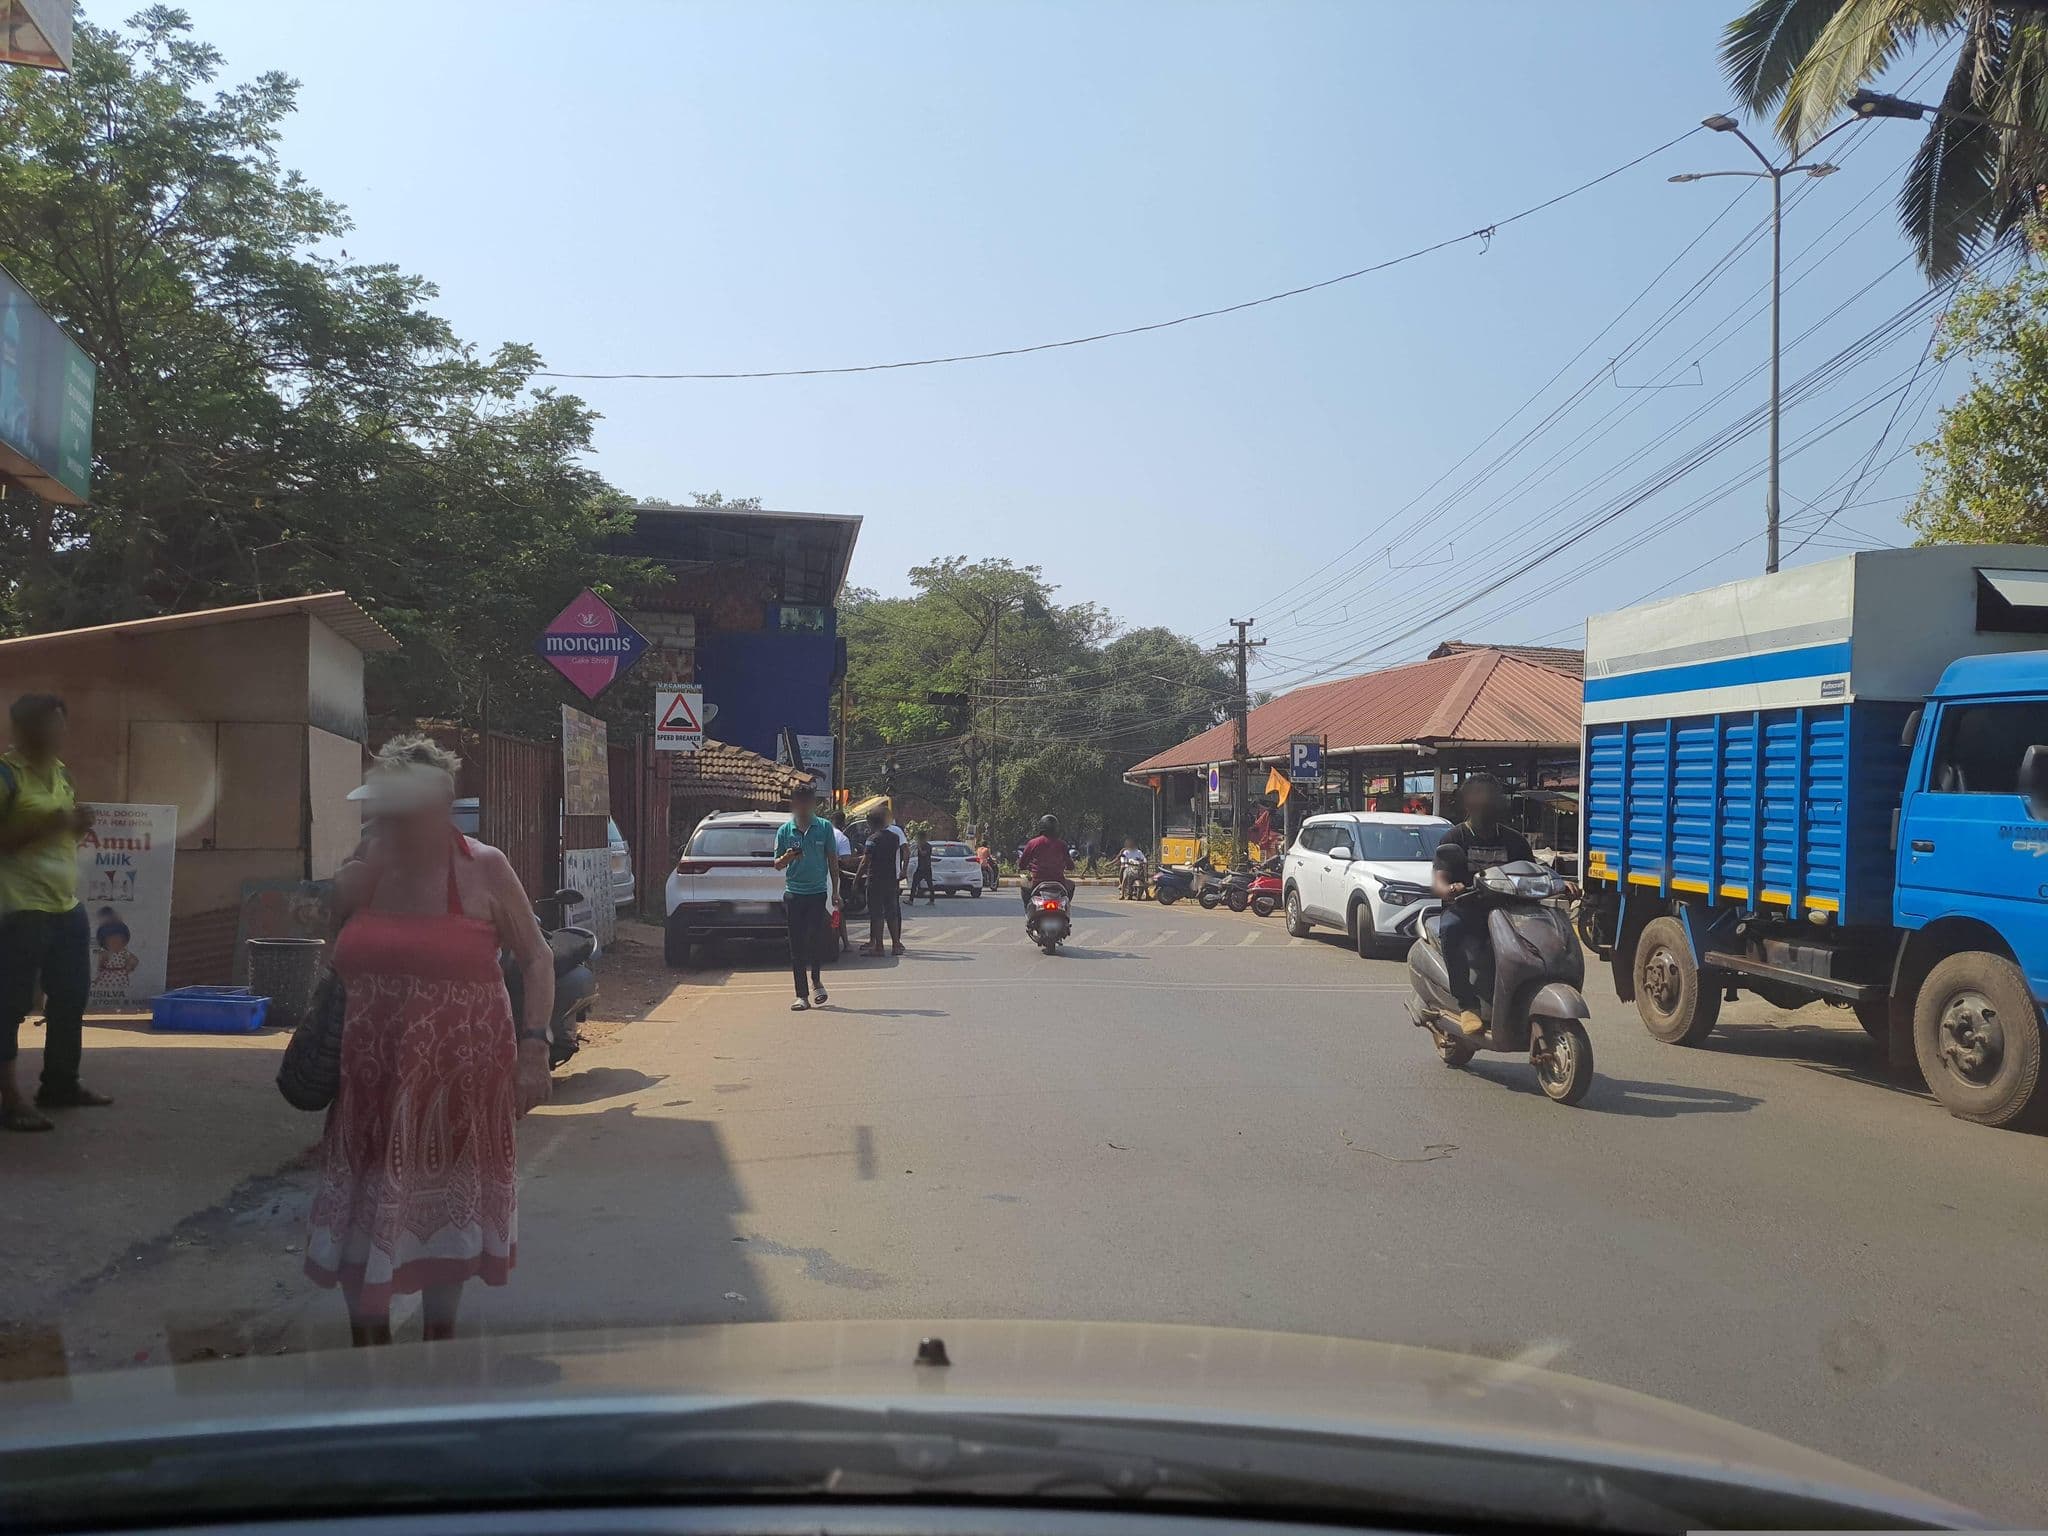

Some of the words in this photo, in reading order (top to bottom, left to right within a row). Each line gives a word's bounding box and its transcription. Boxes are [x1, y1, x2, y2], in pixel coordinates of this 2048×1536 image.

[1293, 744, 1308, 767] P
[78, 831, 151, 851] Amul
[95, 852, 132, 867] Milk
